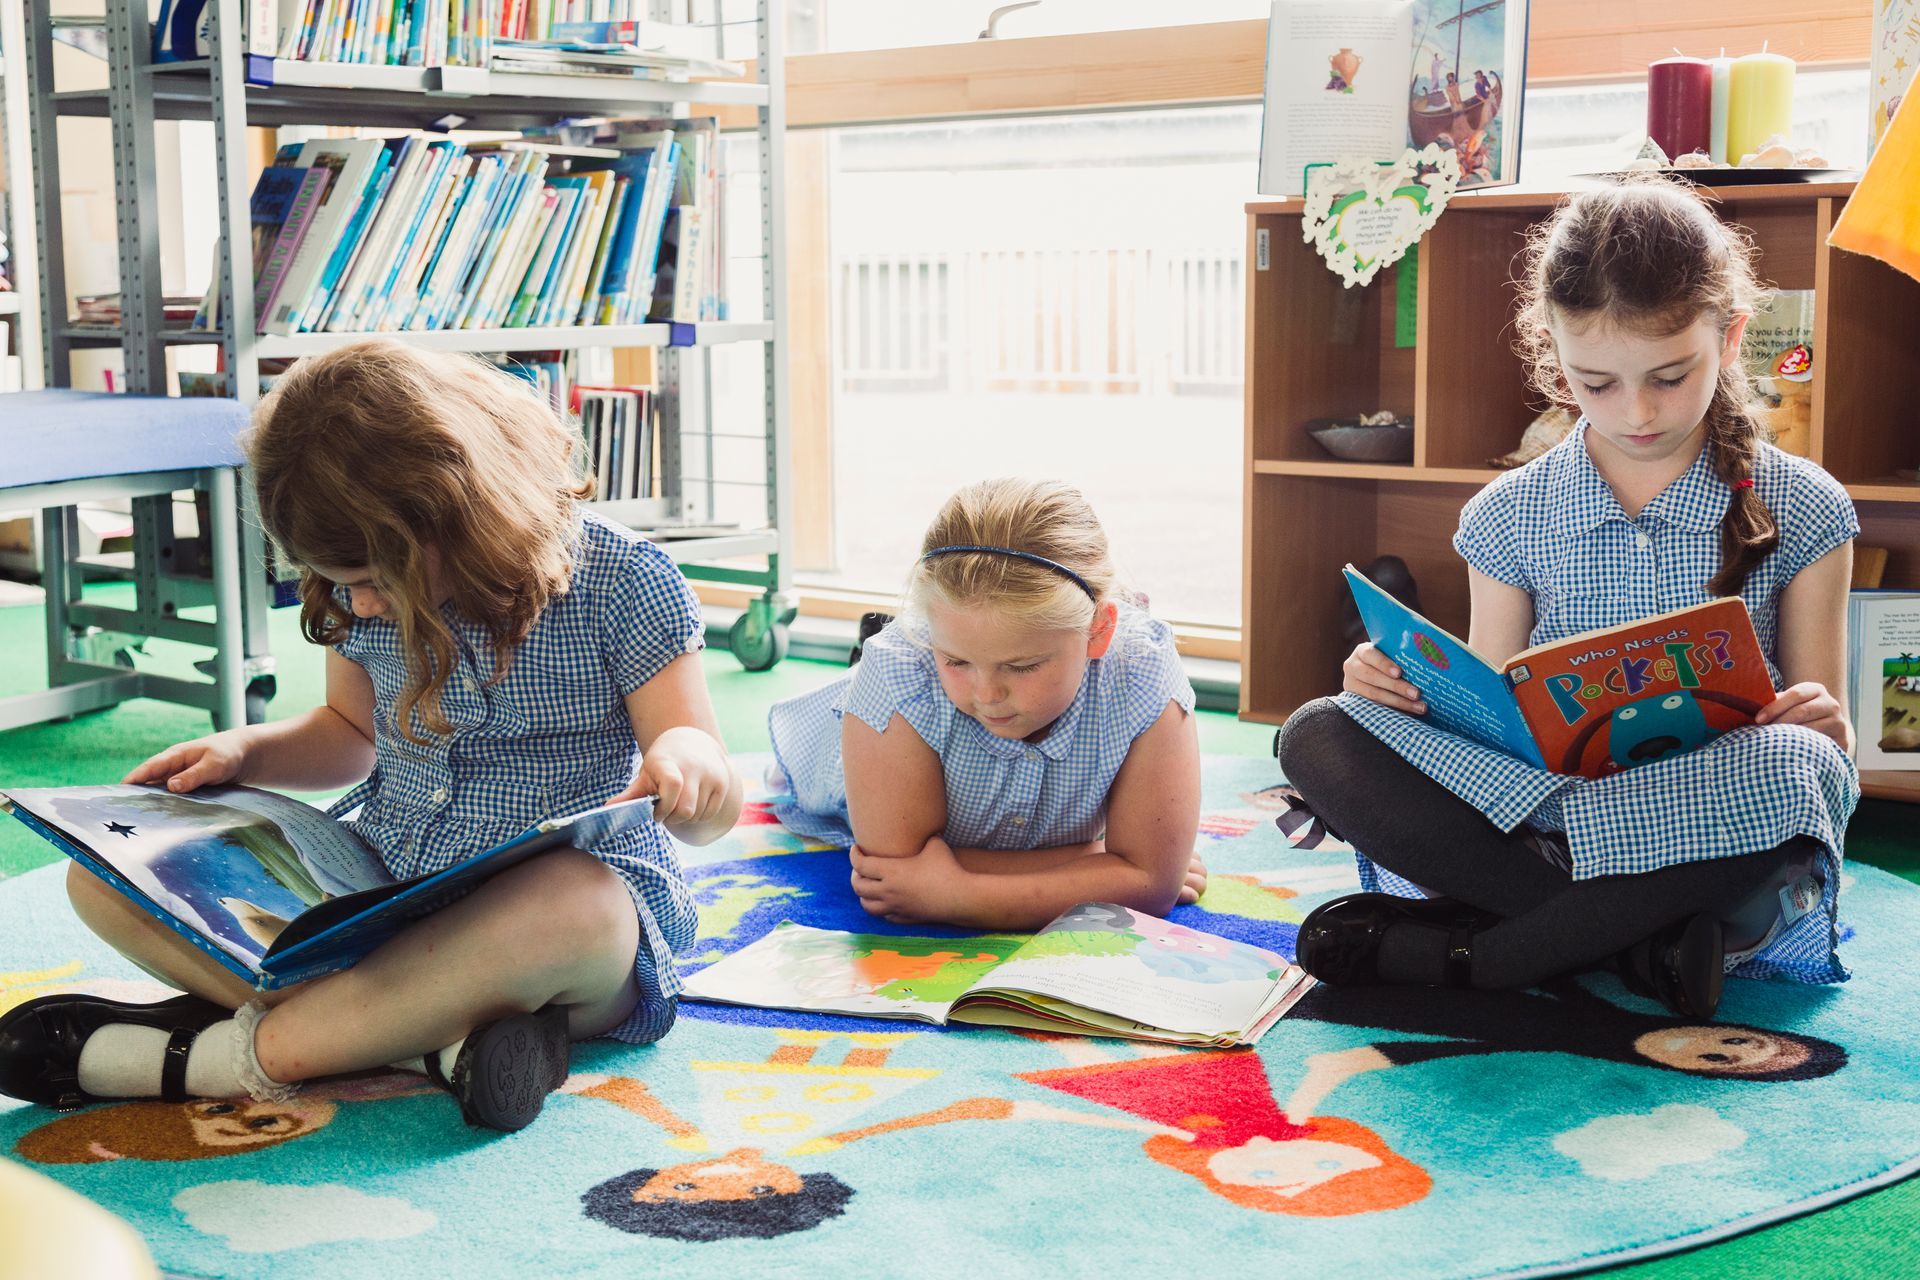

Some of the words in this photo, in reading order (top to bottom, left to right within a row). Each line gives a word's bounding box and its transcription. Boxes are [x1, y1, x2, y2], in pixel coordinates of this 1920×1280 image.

[1774, 327, 1794, 337] God
[1568, 648, 1617, 667] Who
[1624, 628, 1690, 652] Needs
